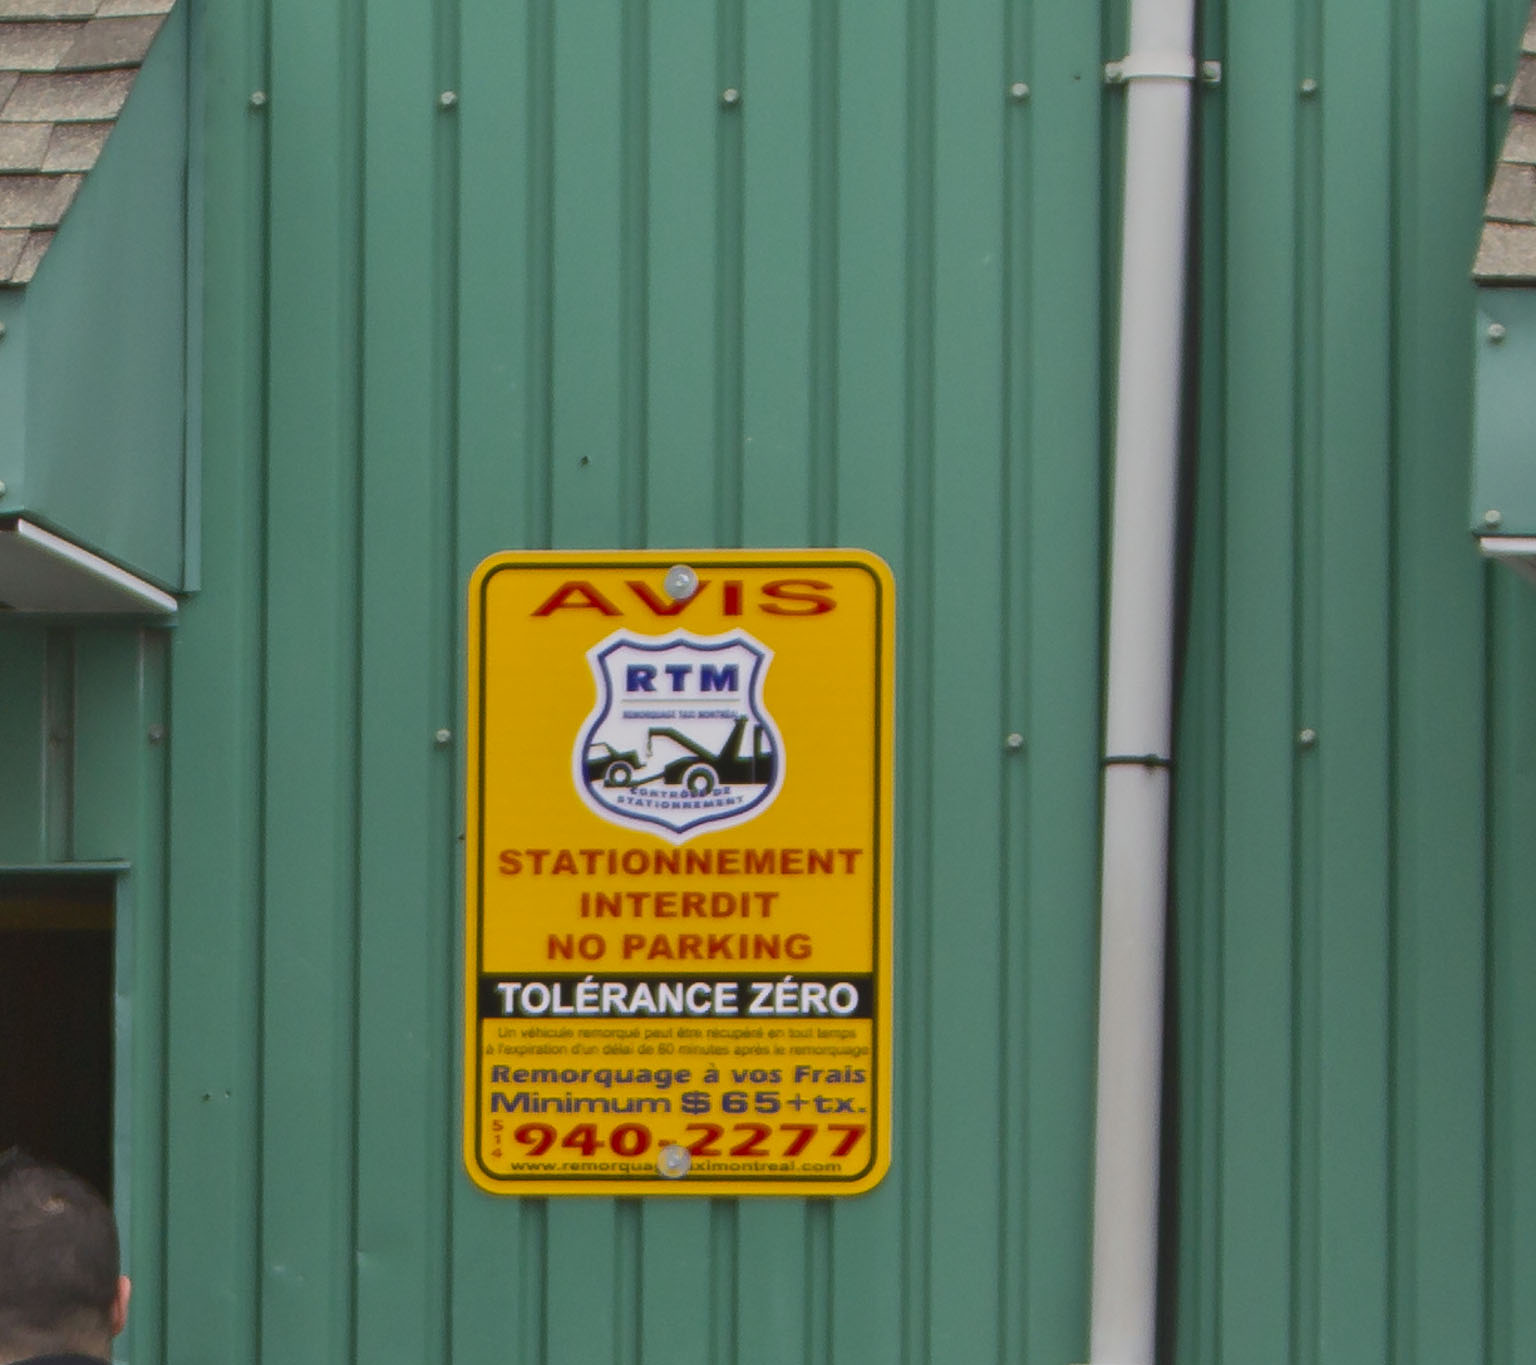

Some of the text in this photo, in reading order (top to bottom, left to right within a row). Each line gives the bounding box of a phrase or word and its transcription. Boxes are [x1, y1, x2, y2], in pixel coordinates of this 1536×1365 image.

[530, 578, 839, 618] AVIS
[626, 663, 740, 692] RTM
[498, 848, 864, 876] STATIONNEMENT
[579, 891, 779, 918] INTERDIT
[546, 934, 813, 961] NO PARKING
[497, 975, 859, 1015] TOLÉRANCE ZÉRO
[491, 1062, 866, 1089] Remorquage à vos Frais
[490, 1091, 671, 1113] Minimum
[513, 1122, 867, 1158] 940-2277
[510, 1161, 842, 1173] www.remorquaximontreal.com
